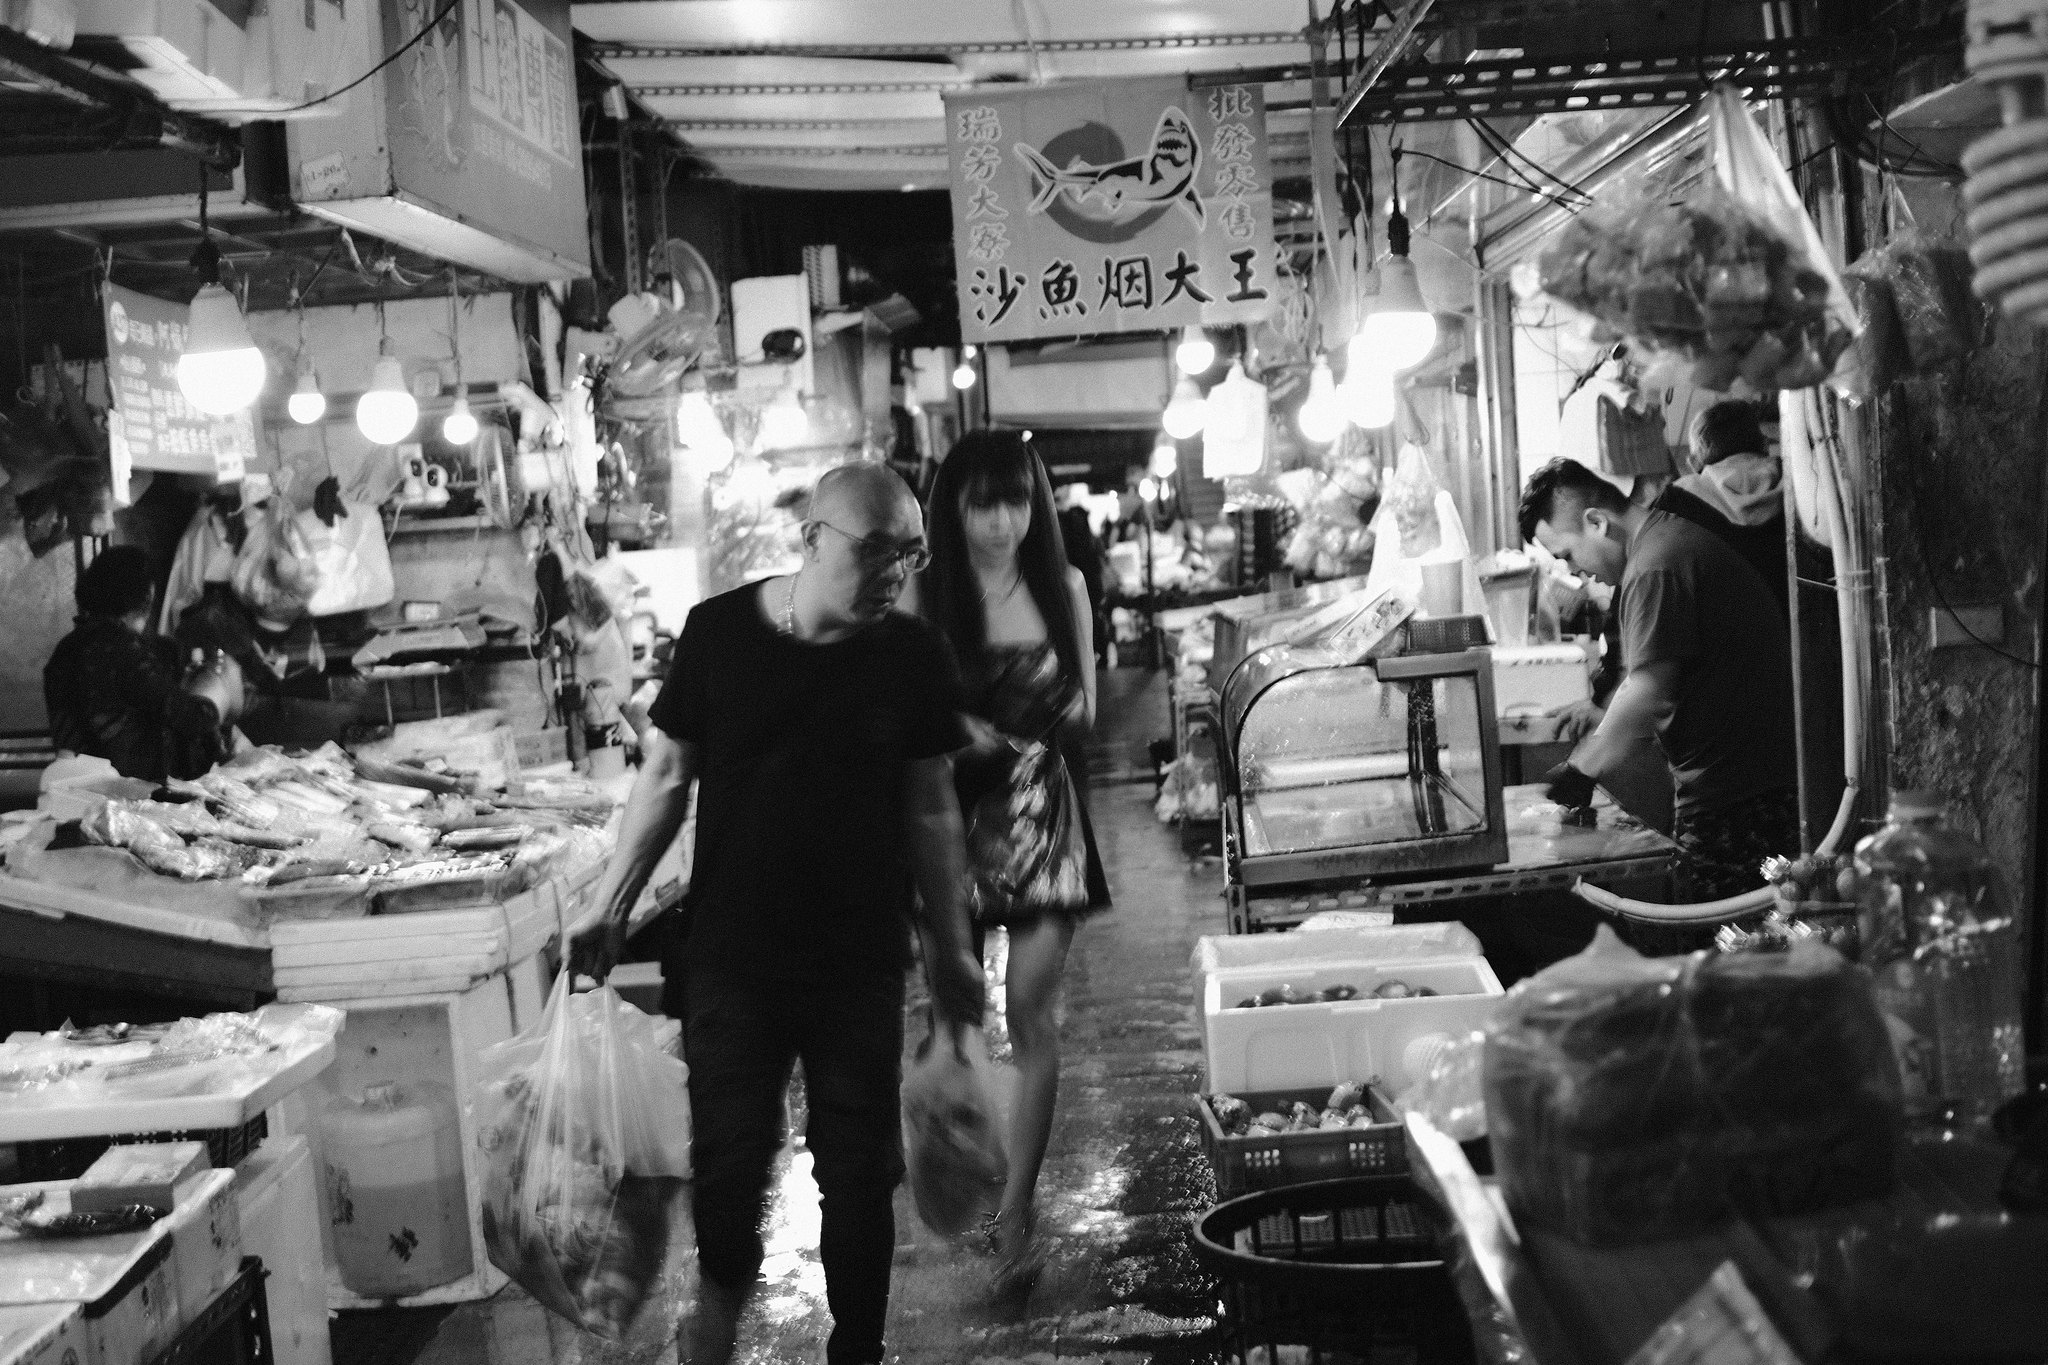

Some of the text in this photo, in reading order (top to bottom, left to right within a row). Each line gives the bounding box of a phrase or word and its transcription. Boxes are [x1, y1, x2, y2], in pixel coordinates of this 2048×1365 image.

[1208, 87, 1259, 241] 批發零售
[970, 248, 1270, 327] 沙魚烟大王
